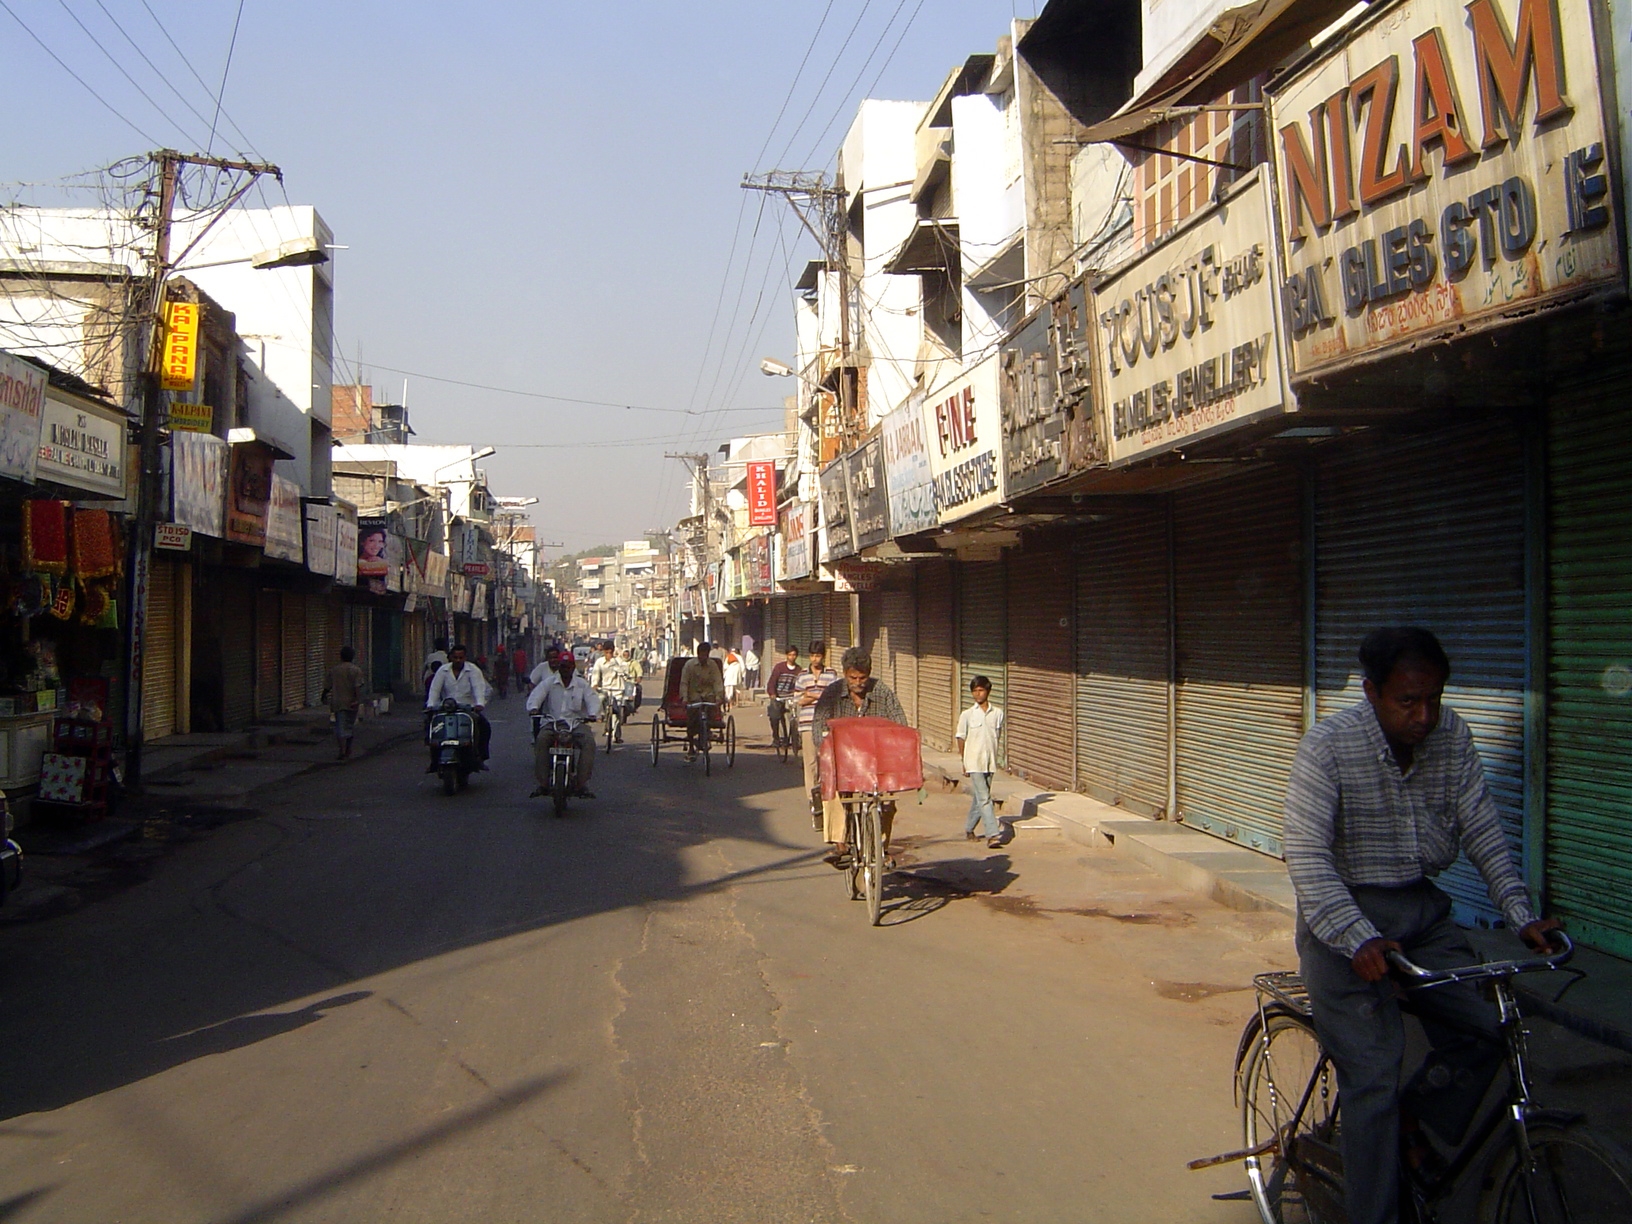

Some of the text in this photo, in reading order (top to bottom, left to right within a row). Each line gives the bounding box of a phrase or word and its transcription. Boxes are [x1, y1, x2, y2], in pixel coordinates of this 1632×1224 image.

[1279, 0, 1574, 243] NIZAM
[1286, 142, 1609, 340] BAGLES STOE
[170, 304, 191, 374] KALPANA
[1172, 332, 1272, 417] JEWELLERY
[171, 403, 211, 418] KALPANA
[935, 384, 978, 457] FINE
[755, 465, 768, 507] KHALID
[158, 524, 190, 536] STD ISD
